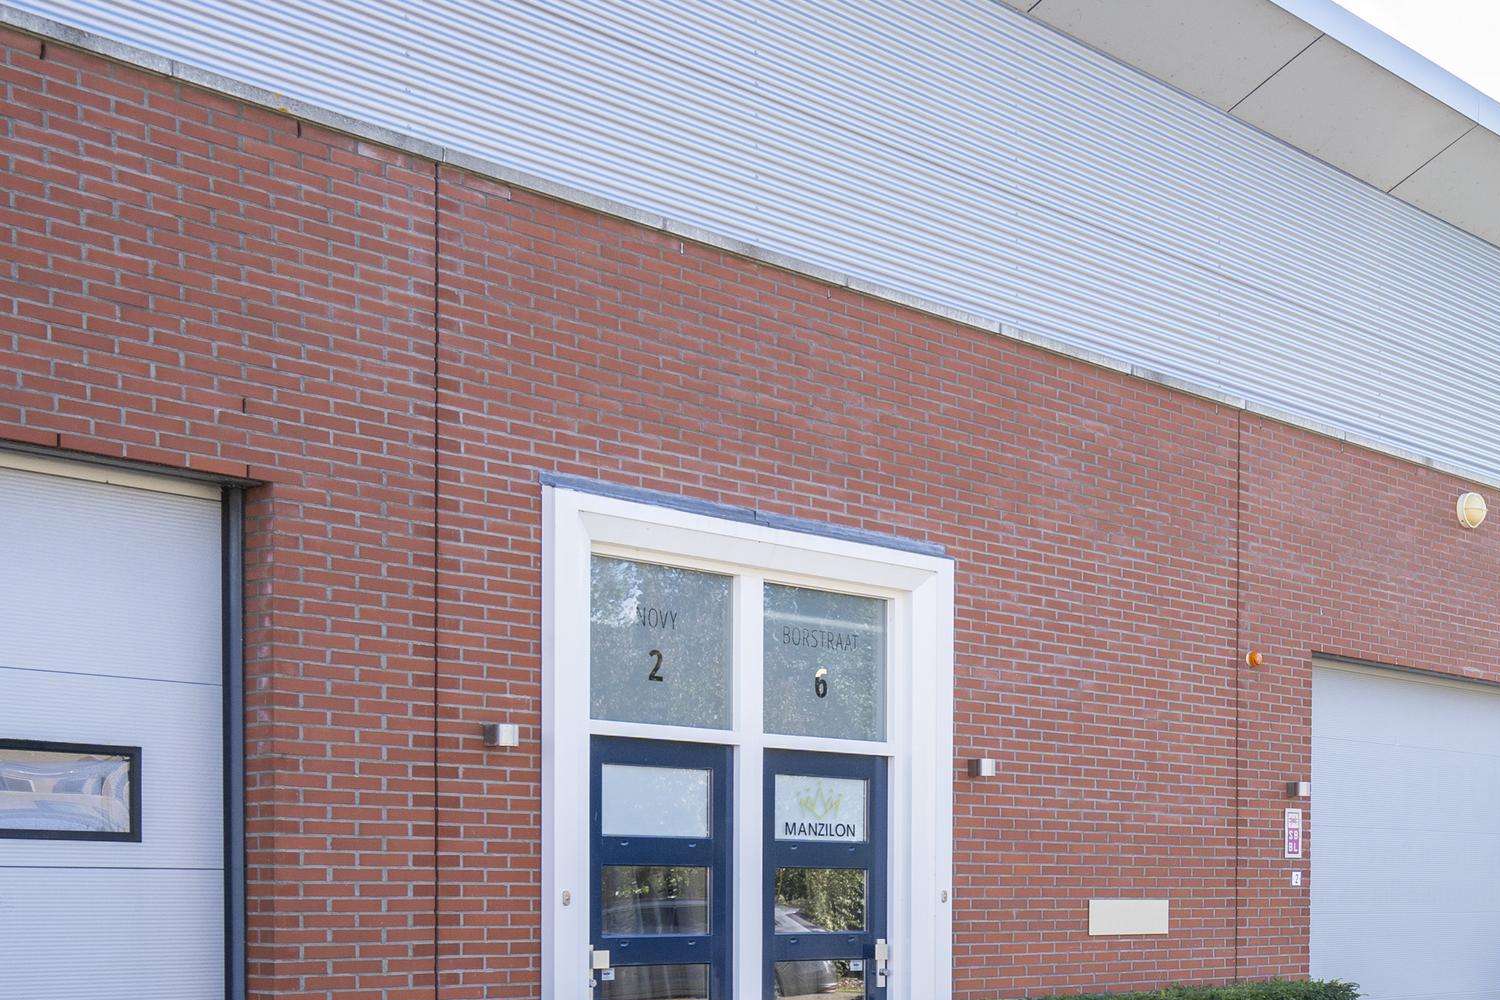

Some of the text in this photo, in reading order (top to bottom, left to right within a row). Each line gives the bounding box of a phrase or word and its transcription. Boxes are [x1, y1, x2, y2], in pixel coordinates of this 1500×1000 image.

[782, 625, 859, 651] BORSTRAAT
[648, 649, 664, 682] 2
[814, 667, 828, 698] 6
[784, 821, 856, 838] MANZILON
